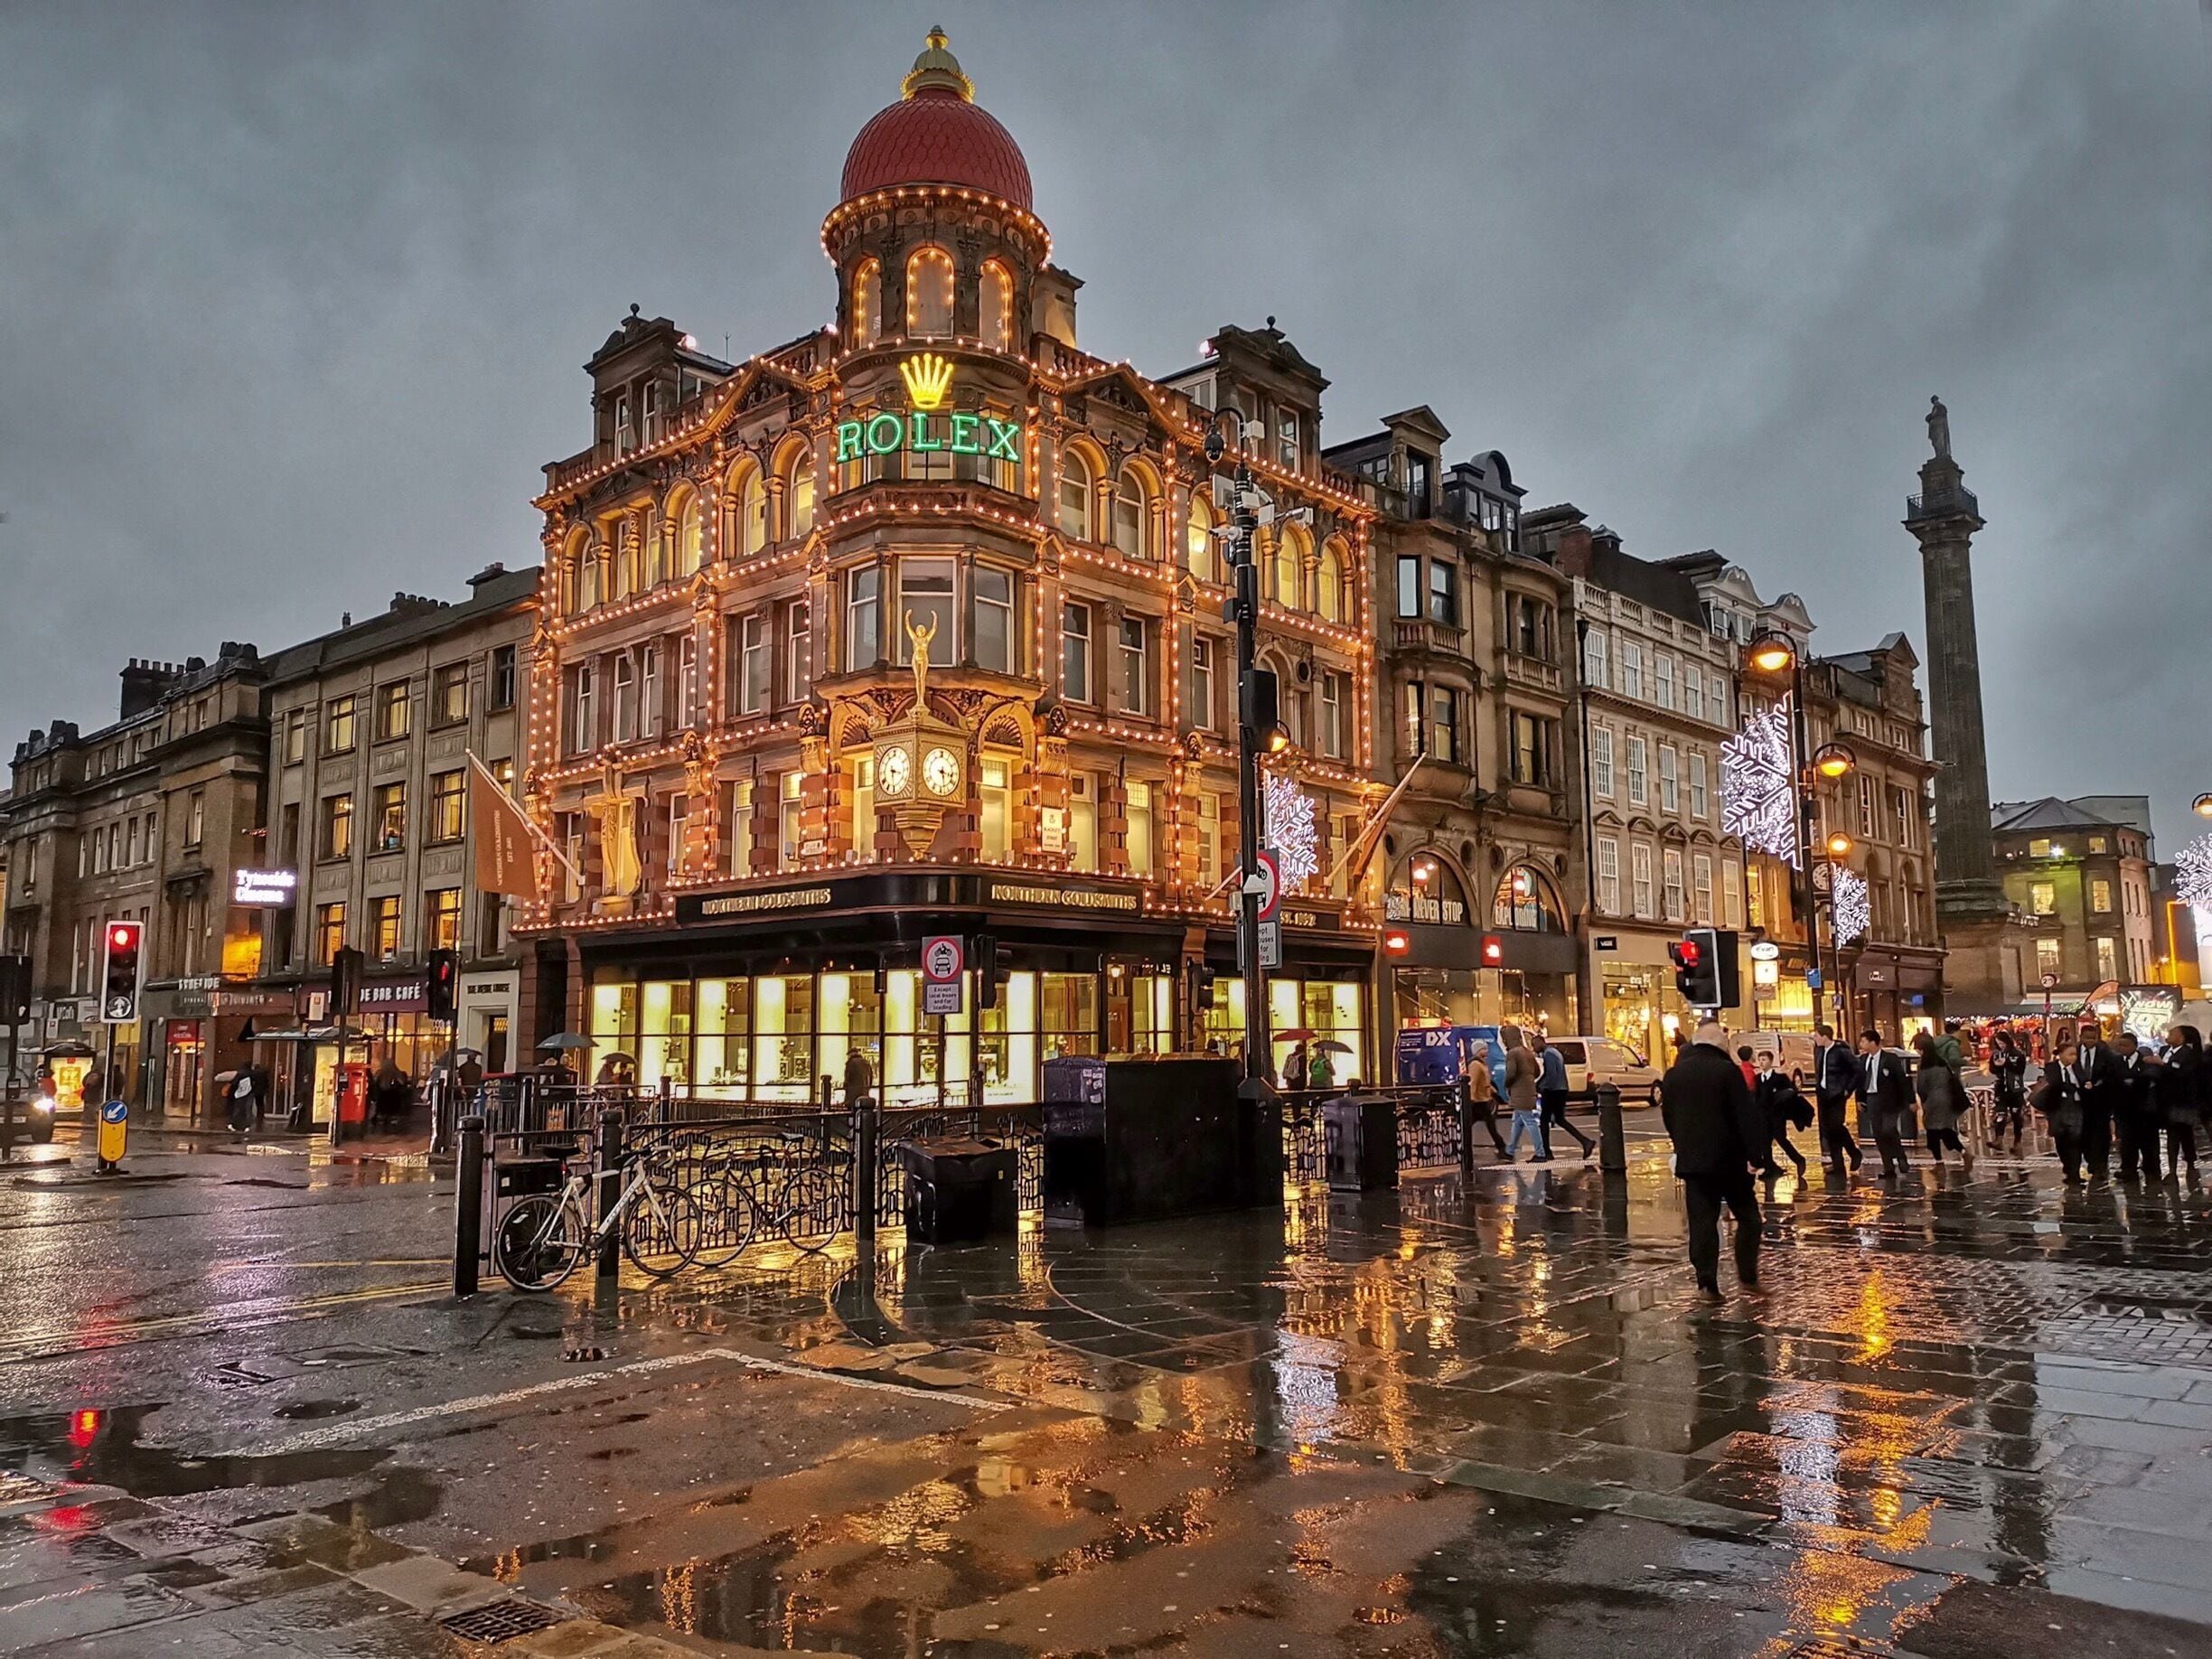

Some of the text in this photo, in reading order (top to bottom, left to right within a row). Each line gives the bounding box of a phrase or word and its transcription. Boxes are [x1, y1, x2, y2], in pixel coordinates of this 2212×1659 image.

[836, 410, 1021, 464] ROLEX
[702, 888, 831, 914] NORTHERN GOLDSMITHS
[991, 885, 1137, 910] NORTHERN GOLDSMITHS
[1413, 898, 1439, 920] NEVER
[1442, 901, 1463, 922] STOP
[372, 987, 392, 1002] BAR
[395, 981, 421, 1000] CAFÉ
[2132, 1000, 2174, 1010] NOW
[1425, 1031, 1452, 1046] DX
